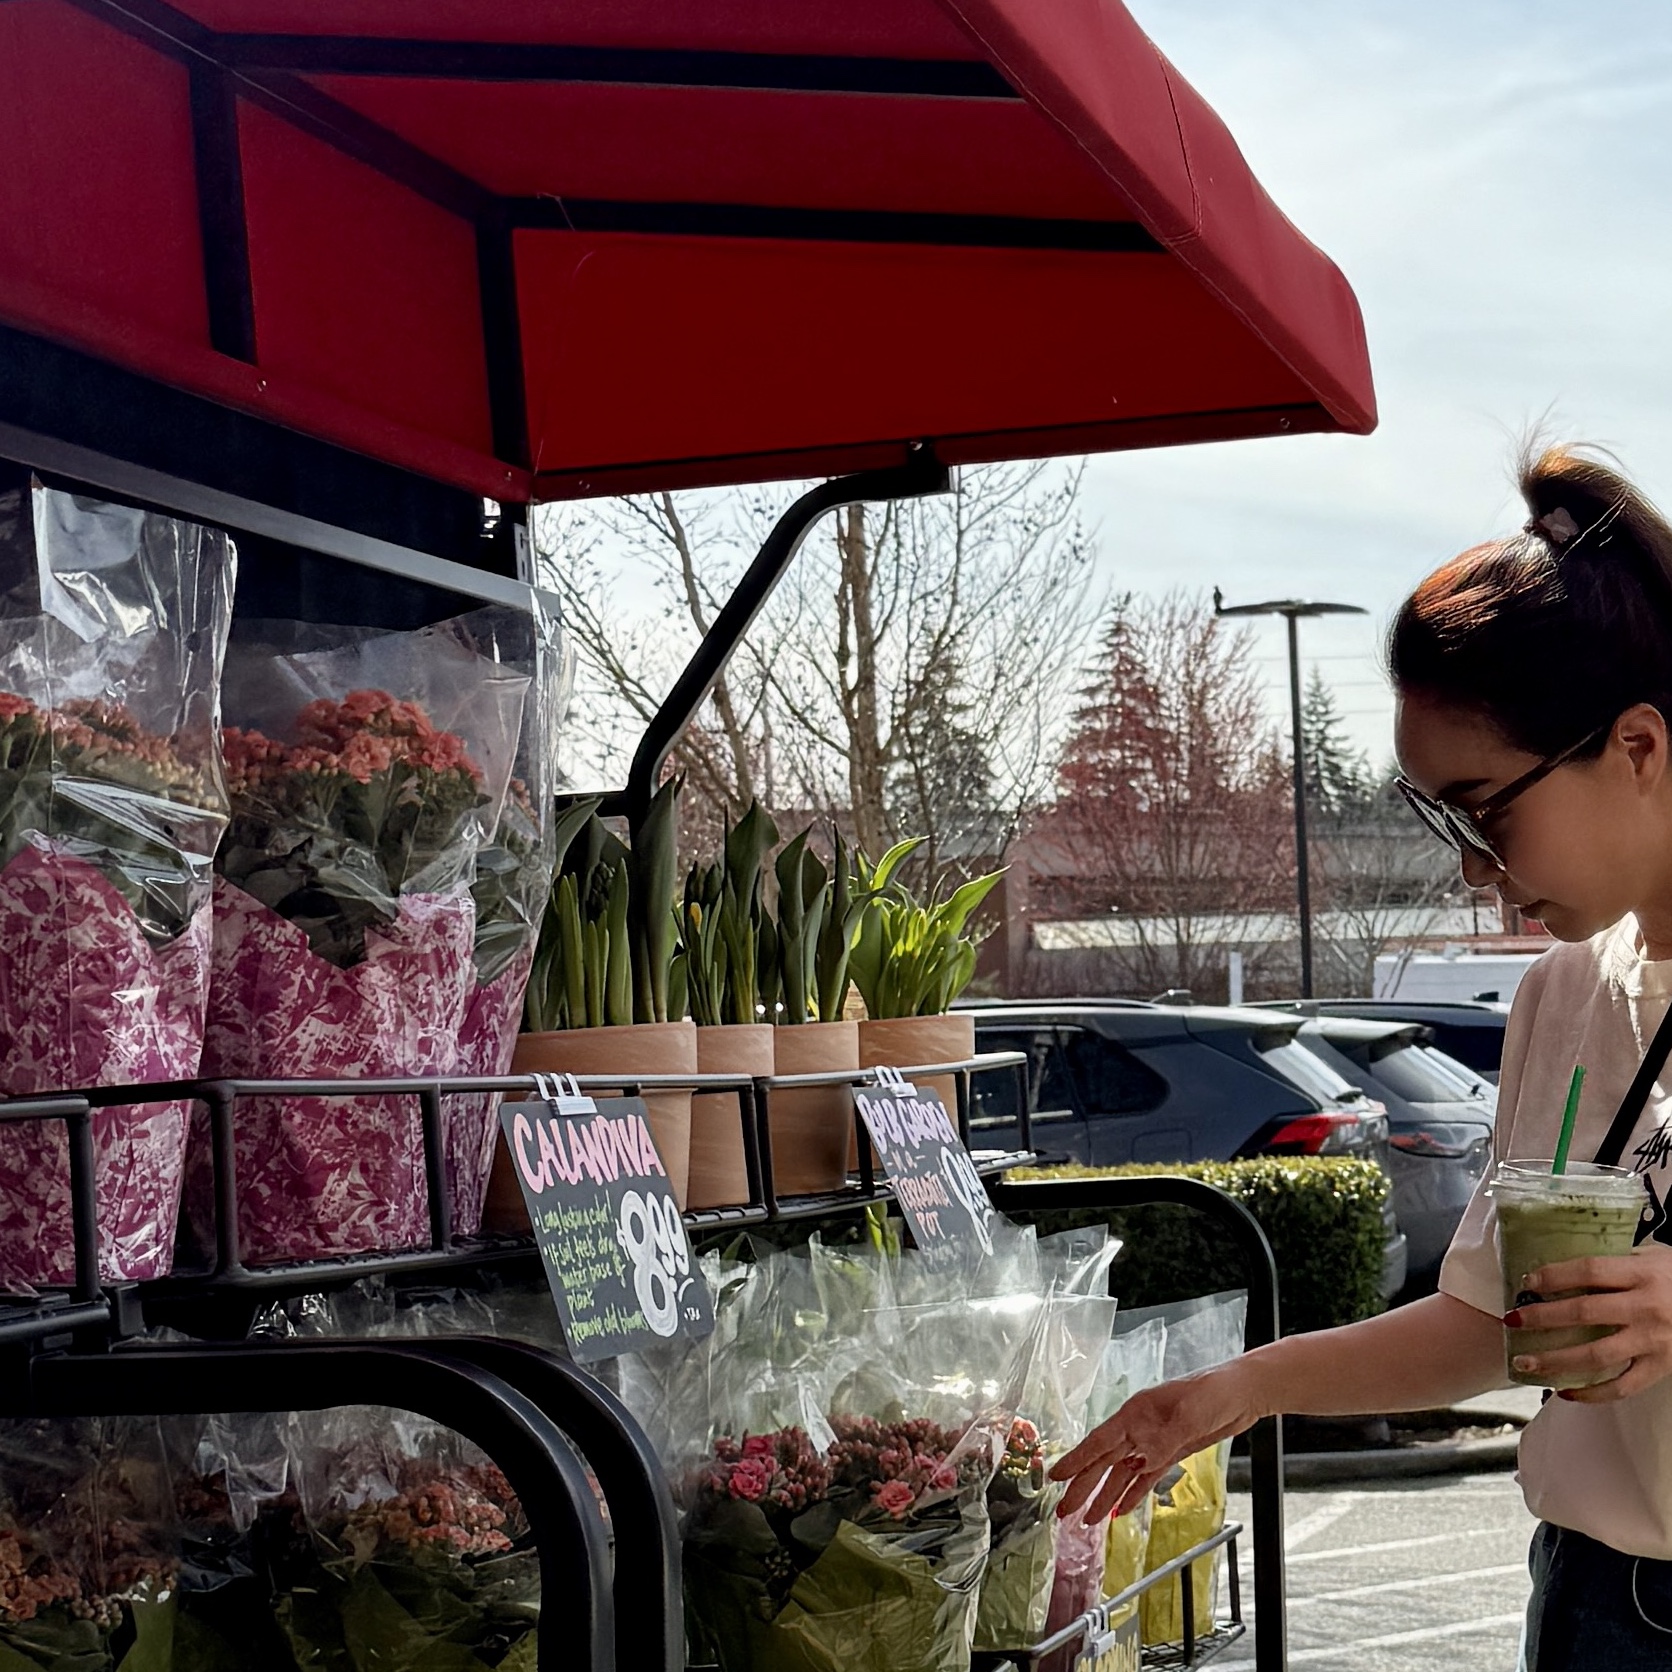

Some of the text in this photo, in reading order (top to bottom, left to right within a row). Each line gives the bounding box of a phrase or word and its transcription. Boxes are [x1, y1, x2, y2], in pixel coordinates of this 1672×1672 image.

[514, 1113, 666, 1194] CALANDIVA
[916, 1210, 946, 1240] POT
[587, 1260, 613, 1285] base
